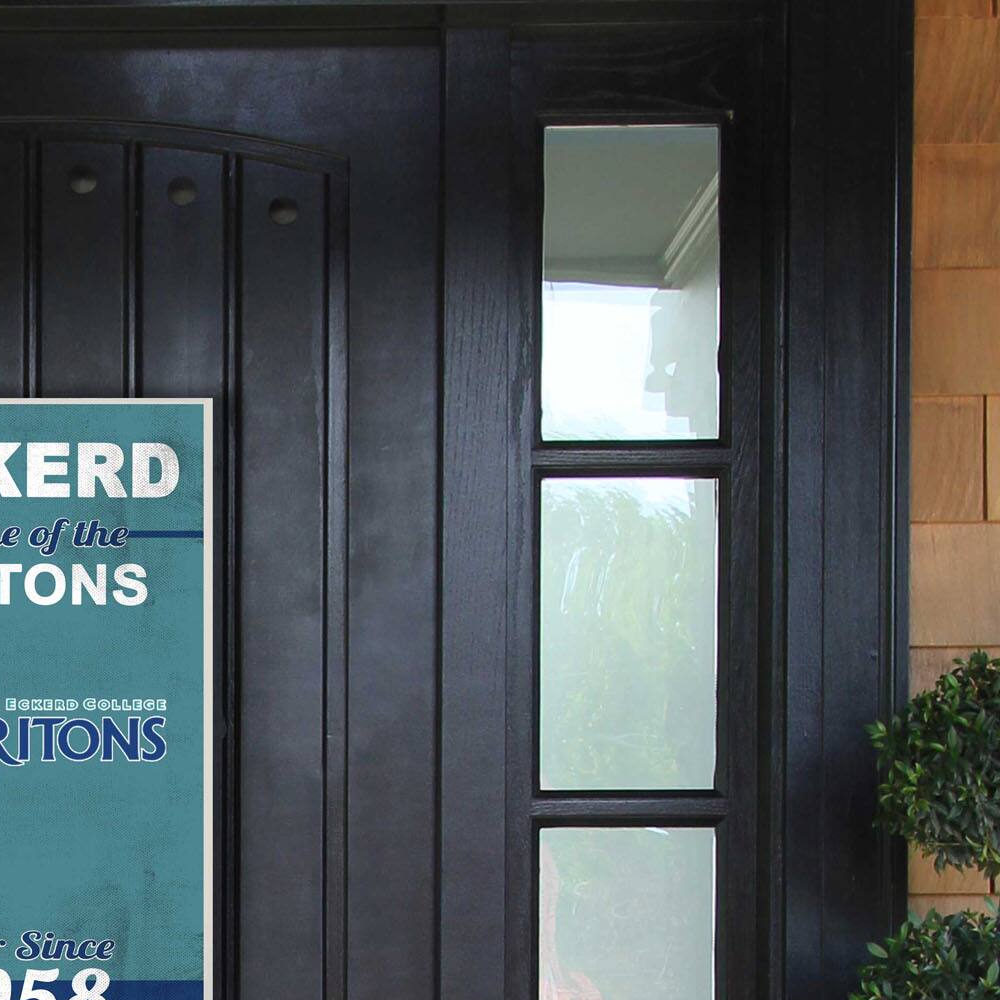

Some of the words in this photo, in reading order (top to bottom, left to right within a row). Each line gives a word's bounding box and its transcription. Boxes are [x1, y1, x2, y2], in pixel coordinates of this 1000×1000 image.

[28, 518, 69, 557] of
[73, 519, 129, 547] the
[5, 698, 79, 711] ECKERD
[82, 698, 167, 711] COLLEGE
[15, 930, 115, 961] Since
